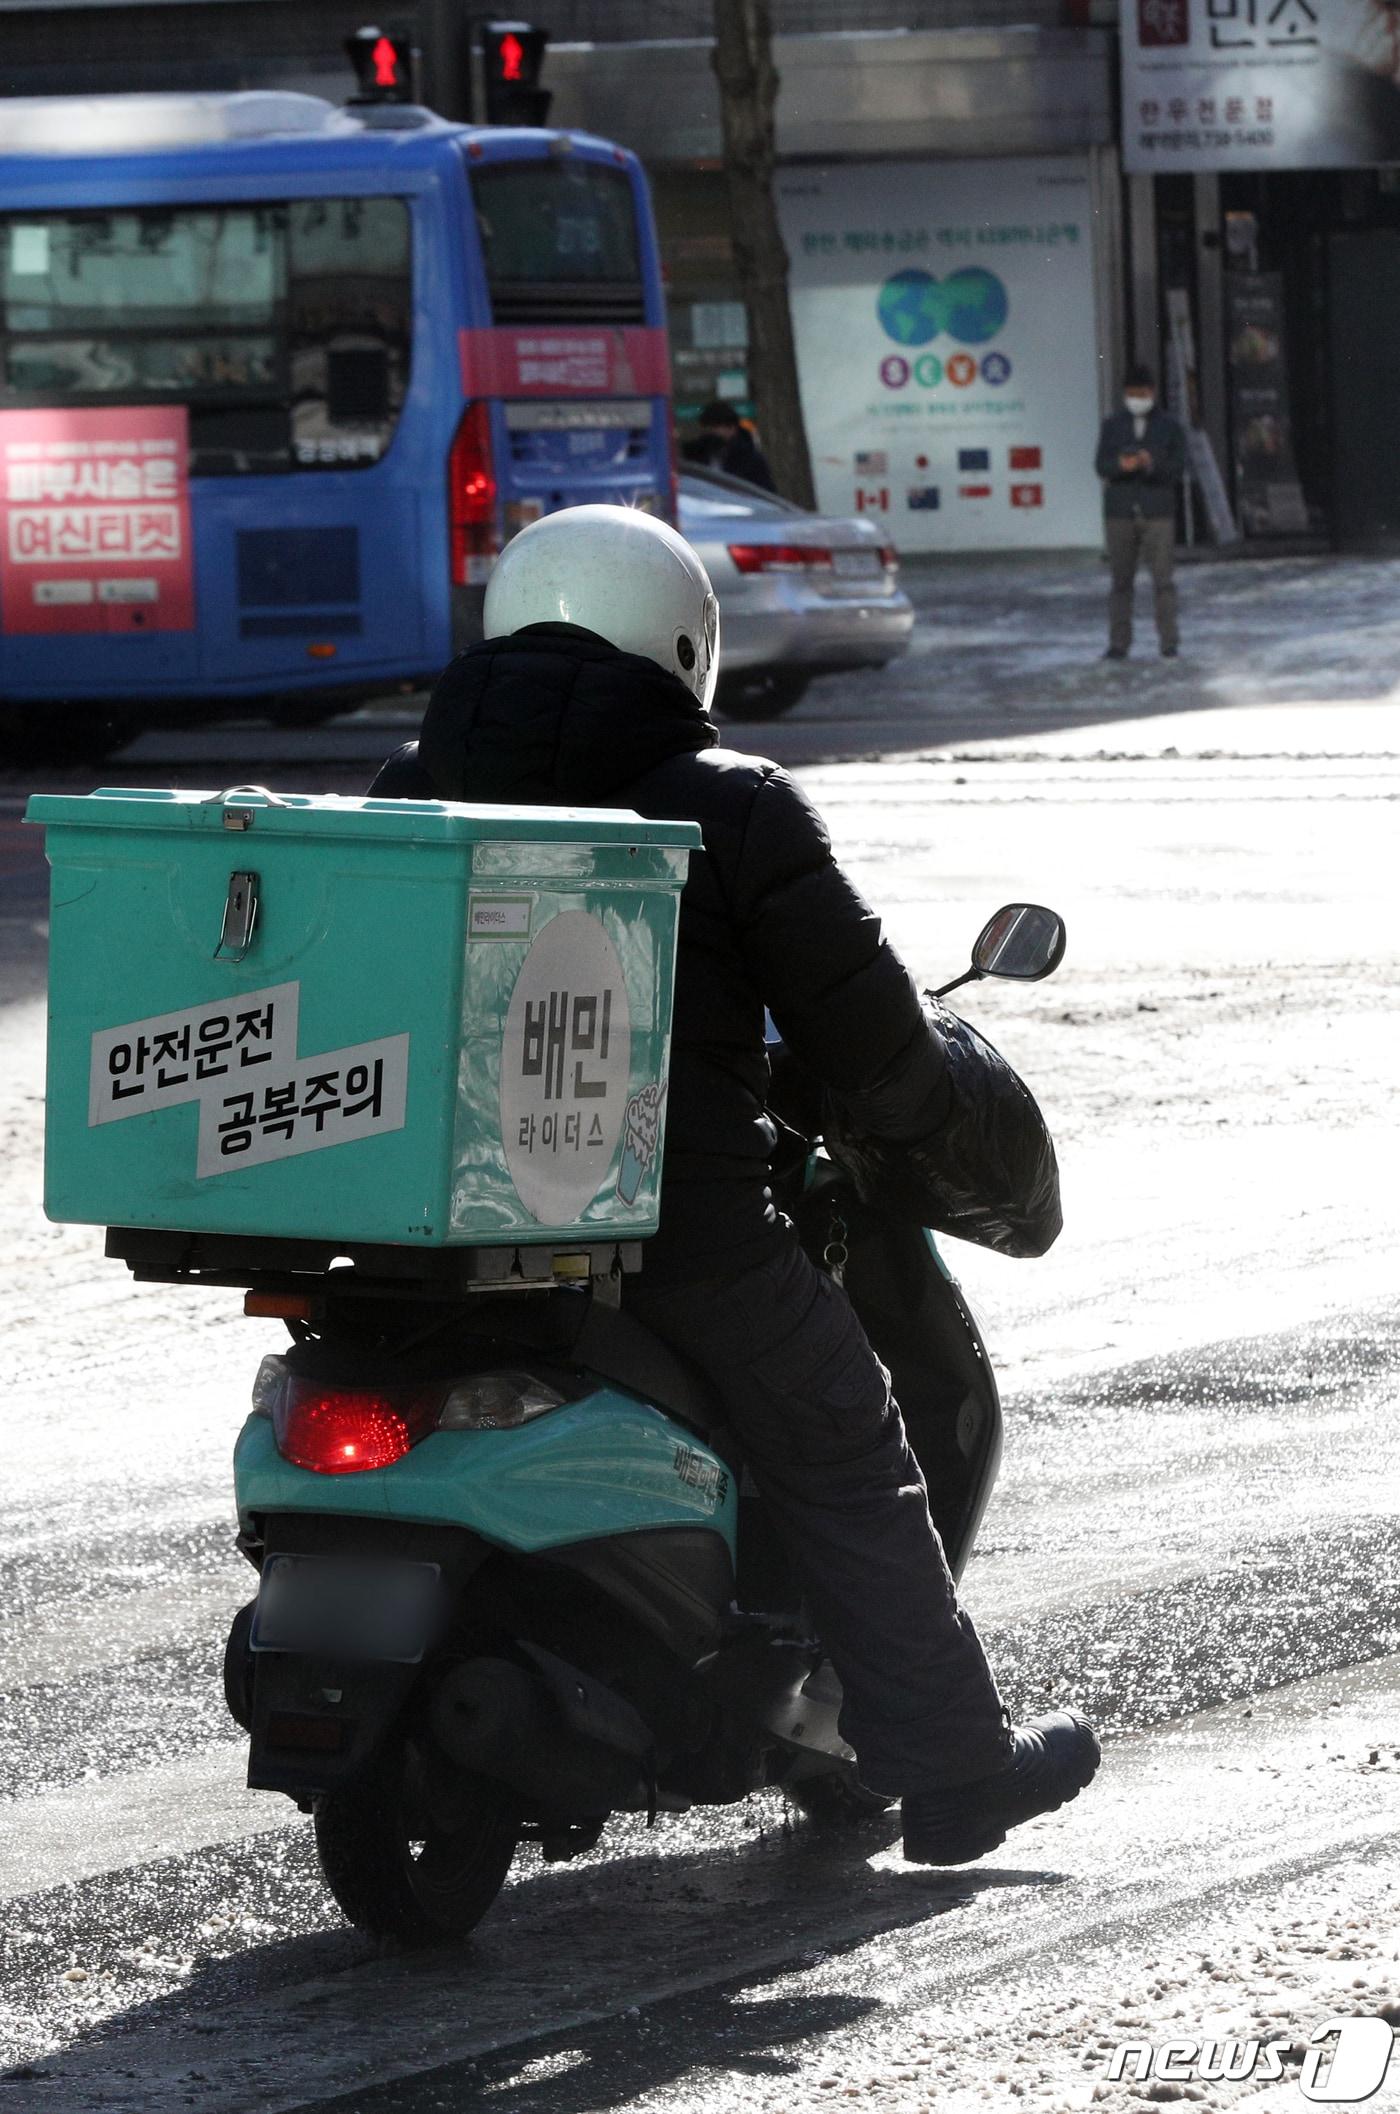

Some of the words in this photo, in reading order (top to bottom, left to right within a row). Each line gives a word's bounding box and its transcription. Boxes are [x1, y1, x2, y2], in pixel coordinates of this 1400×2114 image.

[16, 511, 175, 555] 여신티켓
[108, 1003, 275, 1101] 안전운전
[522, 989, 612, 1100] 배민
[218, 1058, 384, 1156] 공복주의
[519, 1111, 604, 1154] 라이더스
